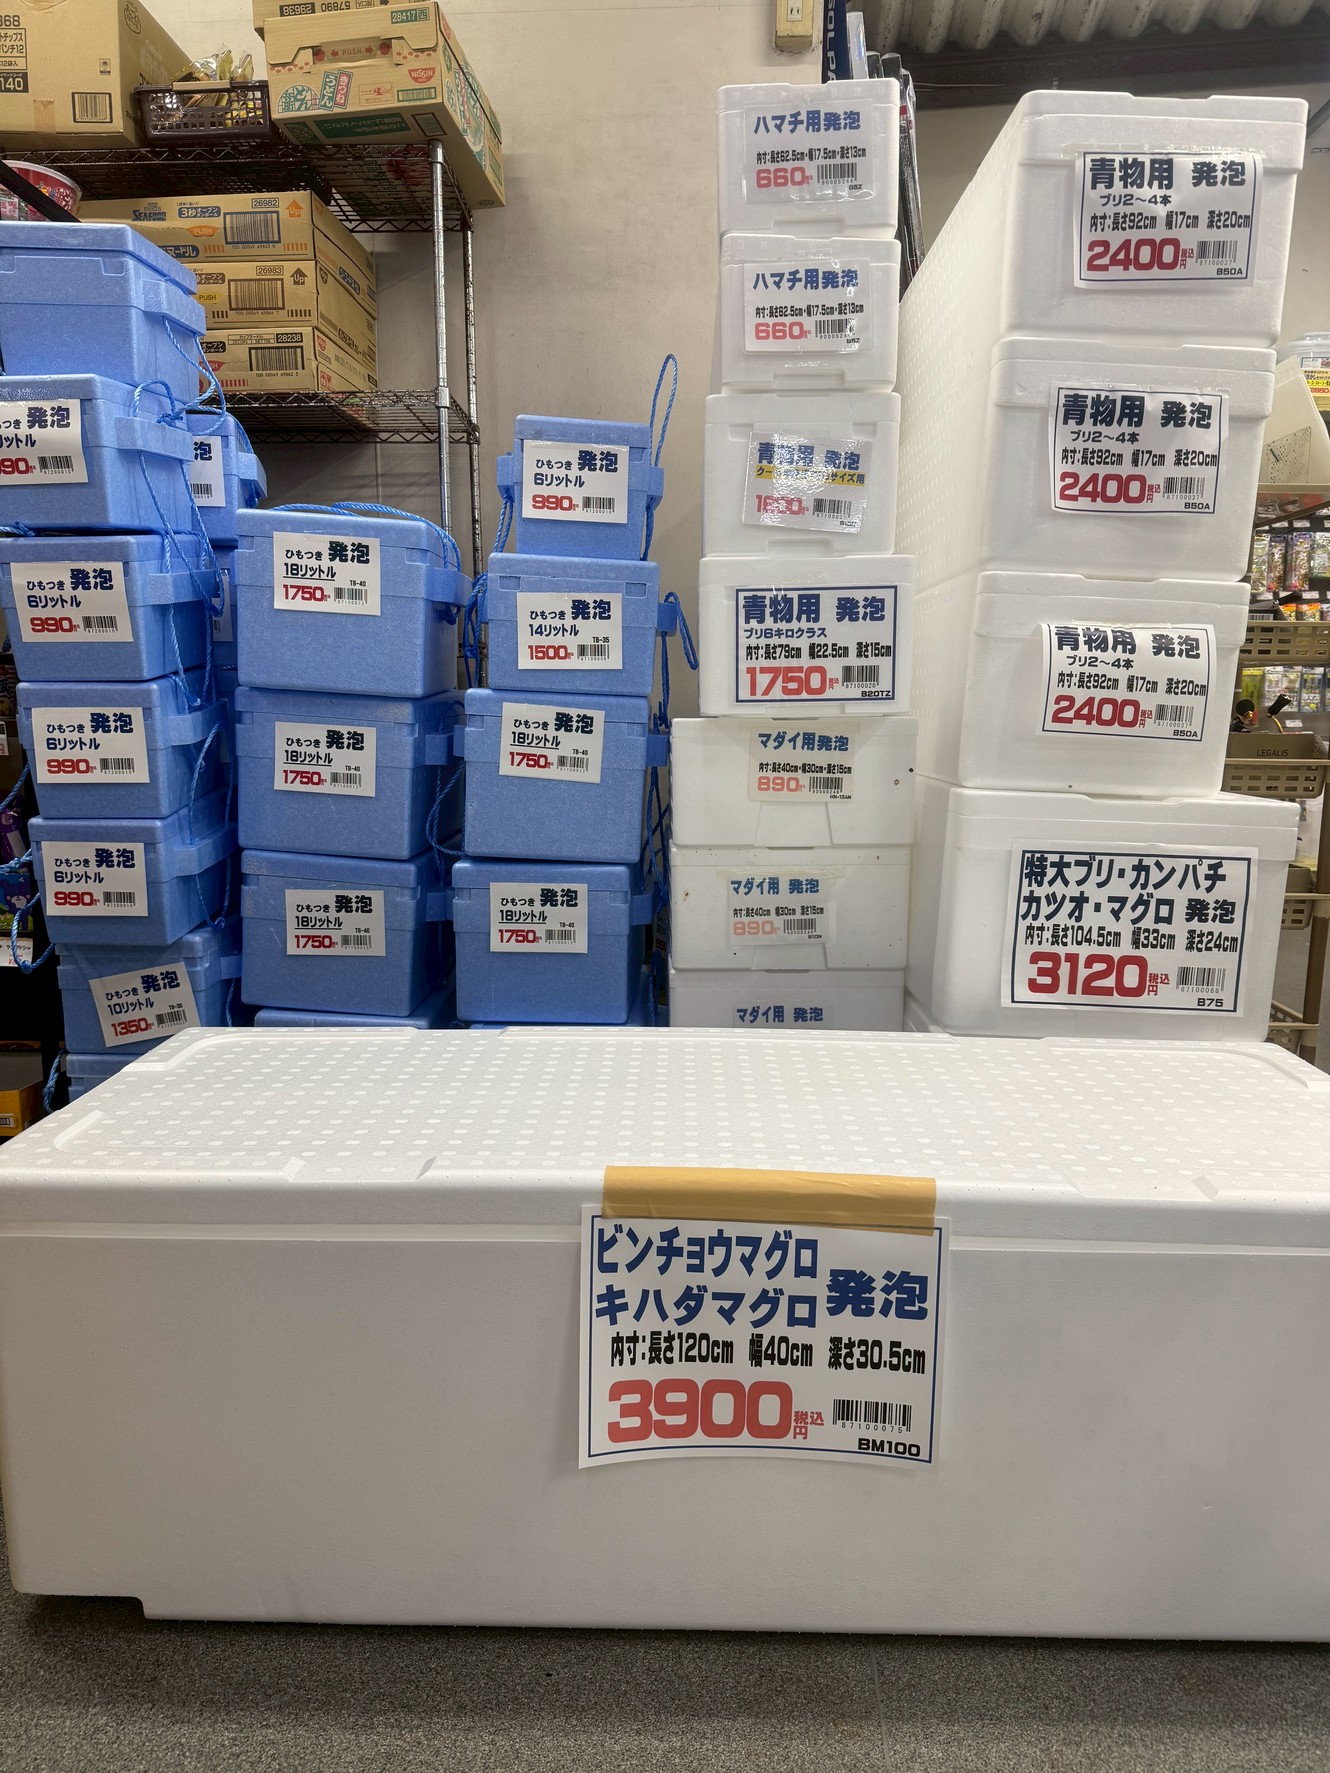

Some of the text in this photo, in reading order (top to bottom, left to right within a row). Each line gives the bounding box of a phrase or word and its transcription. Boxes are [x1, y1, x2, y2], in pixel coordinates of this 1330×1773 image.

[283, 1, 351, 15] 57890 29638
[392, 11, 416, 22] 28417
[342, 48, 362, 56] PUSH
[411, 69, 433, 79] NISSIN
[321, 75, 336, 107] うどん
[753, 109, 861, 135] ハマチ用発泡
[755, 166, 806, 189] 660
[1089, 157, 1246, 191] 青物用 発泡
[253, 199, 278, 207] 26982
[289, 206, 300, 216] Up
[132, 209, 167, 222] SEAFOOD
[181, 208, 197, 218] 3秒
[1090, 210, 1250, 233] 内寸:長さ92cm 幅17cm 深さ20cm
[1086, 238, 1181, 272] 2400
[1181, 248, 1195, 259] 税込
[1199, 258, 1233, 266] 87100037
[257, 267, 282, 275] 26983
[1179, 259, 1187, 269] 円
[1216, 267, 1244, 277] B50A
[294, 273, 304, 283] Up
[752, 267, 859, 292] ハマチ用発泡
[277, 334, 302, 343] 28238
[754, 321, 804, 341] 660
[26, 405, 71, 429] 発泡
[1062, 394, 1213, 430] 青物用 発泡
[535, 449, 619, 473] ひもつき 発泡
[823, 449, 861, 472] 発泡
[1061, 447, 1218, 469] 内寸:長さ92cm 幅17cm 深さ20cm
[533, 472, 585, 488] 6リットル
[1059, 471, 1147, 504] 2400
[1147, 483, 1161, 494] 税込
[531, 494, 572, 512] 990
[1146, 493, 1154, 503] 円
[1166, 493, 1201, 501] 87100037
[1183, 501, 1211, 511] B50A
[285, 540, 370, 564] ひもつき 発泡
[284, 562, 336, 579] 18リットル
[26, 568, 114, 591] ひもつき 発泡
[350, 579, 367, 587] TB-40
[27, 594, 81, 609] 6リットル
[282, 584, 324, 602] 1750
[530, 599, 612, 621] ひもつき 発泡
[742, 593, 886, 625] 青物用 発泡
[29, 617, 73, 633] 990
[528, 623, 579, 637] 14リットル
[743, 627, 828, 640] ブリ6キロクラス
[745, 641, 892, 661] 内寸:長さ79cm 幅22.5cm 深さ15cm
[1054, 625, 1201, 660] 青物用 発泡
[527, 644, 568, 660] 1500
[745, 664, 827, 697] 1750
[1056, 671, 1207, 697] 内寸:長さ92cm 幅17cm 深さ20cm
[860, 690, 892, 698] B20TZ
[1050, 694, 1140, 729] 2400
[1139, 709, 1153, 720] 税込
[46, 712, 134, 734] ひもつき 発泡
[513, 711, 594, 735] ひもつき 発泡
[1138, 719, 1146, 729] 円
[1157, 720, 1191, 729] 87100037
[285, 729, 364, 751] ひもつき 発泡
[511, 731, 561, 748] 18リットル
[757, 731, 849, 752] マダイ用発泡
[1172, 728, 1199, 739] B50A
[46, 737, 100, 751] 6リットル
[284, 750, 333, 764] 18リットル
[509, 751, 548, 769] 1750
[1256, 749, 1289, 757] LEGALIS
[46, 758, 90, 774] 990
[282, 769, 321, 786] 1750
[757, 776, 800, 793] 890
[54, 847, 136, 869] ひもつき 発泡
[54, 870, 104, 884] 6リットル
[1024, 854, 1227, 894] 特大ブリ・カンパチ
[730, 876, 820, 896] マダイ用 発泡
[53, 890, 94, 907] 990
[296, 894, 373, 914] ひもつき 発泡
[500, 888, 579, 908] ひもつき 発泡
[499, 909, 548, 923] 18リットル
[1021, 890, 1236, 926] カツオ・マグロ 発泡
[295, 915, 343, 928] 18リットル
[733, 920, 774, 936] 890
[294, 934, 332, 949] 1750
[498, 929, 537, 944] 1750
[1024, 923, 1240, 954] 内寸:長さ104.5cm 幅33cm 深さ24cm
[1027, 951, 1149, 999] 3120
[1148, 972, 1170, 985] 税込
[105, 970, 181, 1001] ひもつき 発泡
[1147, 984, 1159, 996] 円
[1180, 985, 1219, 994] 87100068
[107, 998, 154, 1016] 10リットル
[1197, 997, 1224, 1008] B75
[736, 1005, 824, 1024] マダイ用 発泡
[111, 1017, 149, 1037] 1350
[596, 1223, 819, 1281] ビンチョウマグロ
[595, 1269, 929, 1329] キハダマグロ 発泡
[610, 1330, 926, 1375] 内寸:長さ120cm 幅40cm 深さ30.5cm
[607, 1378, 794, 1444] 3900
[793, 1410, 825, 1427] 税込
[793, 1425, 809, 1440] 円
[840, 1422, 904, 1434] 87100075
[857, 1437, 922, 1458] BM100
